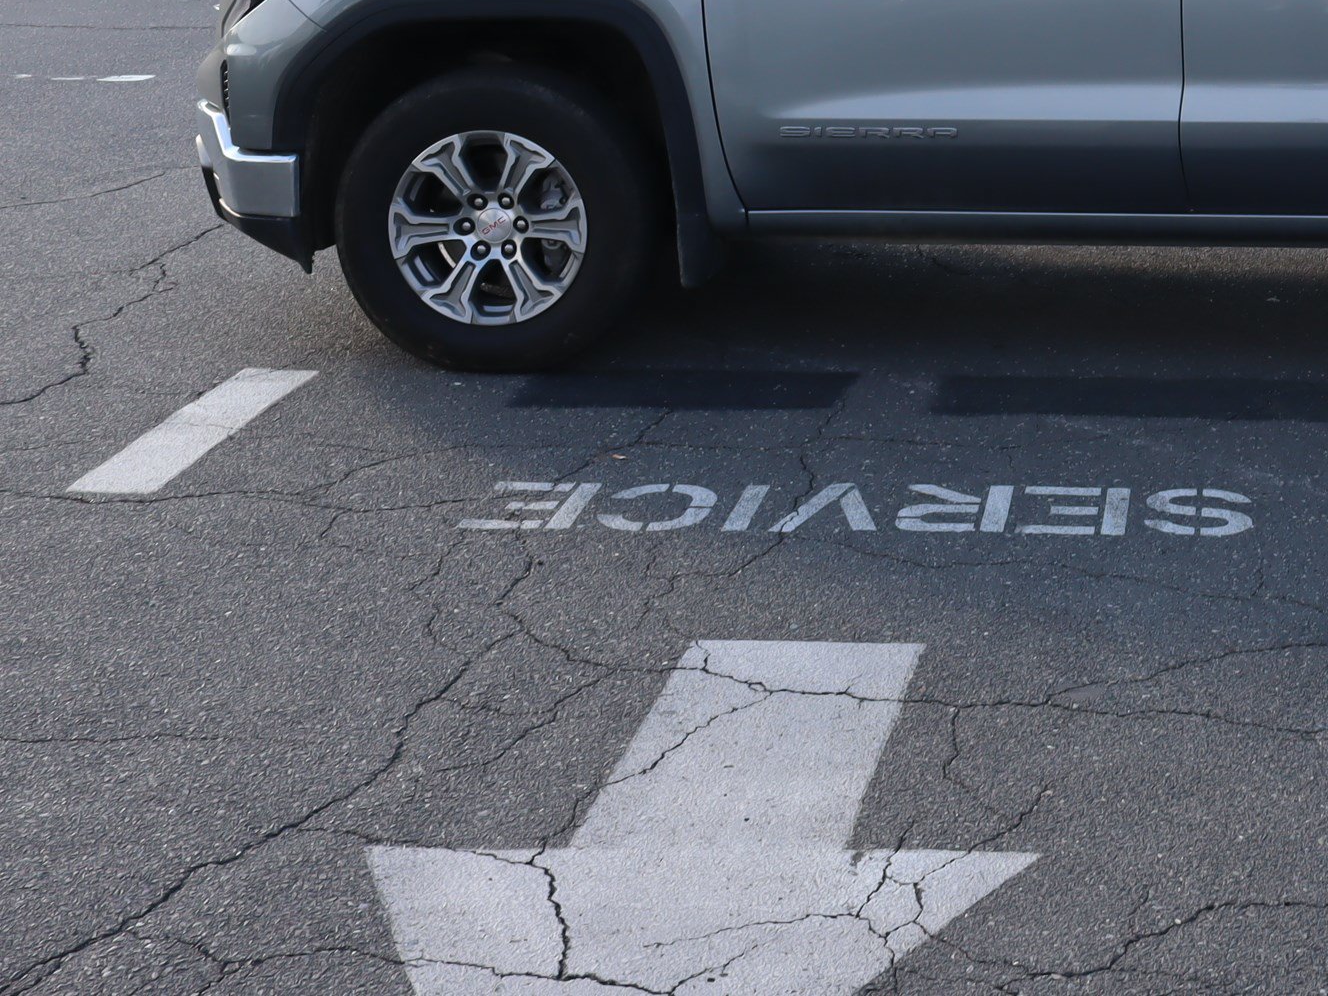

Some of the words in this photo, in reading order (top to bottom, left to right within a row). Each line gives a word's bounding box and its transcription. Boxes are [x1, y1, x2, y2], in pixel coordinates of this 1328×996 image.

[779, 125, 959, 139] SIERRA
[481, 215, 507, 236] GMC
[457, 481, 1255, 537] SERVICE
